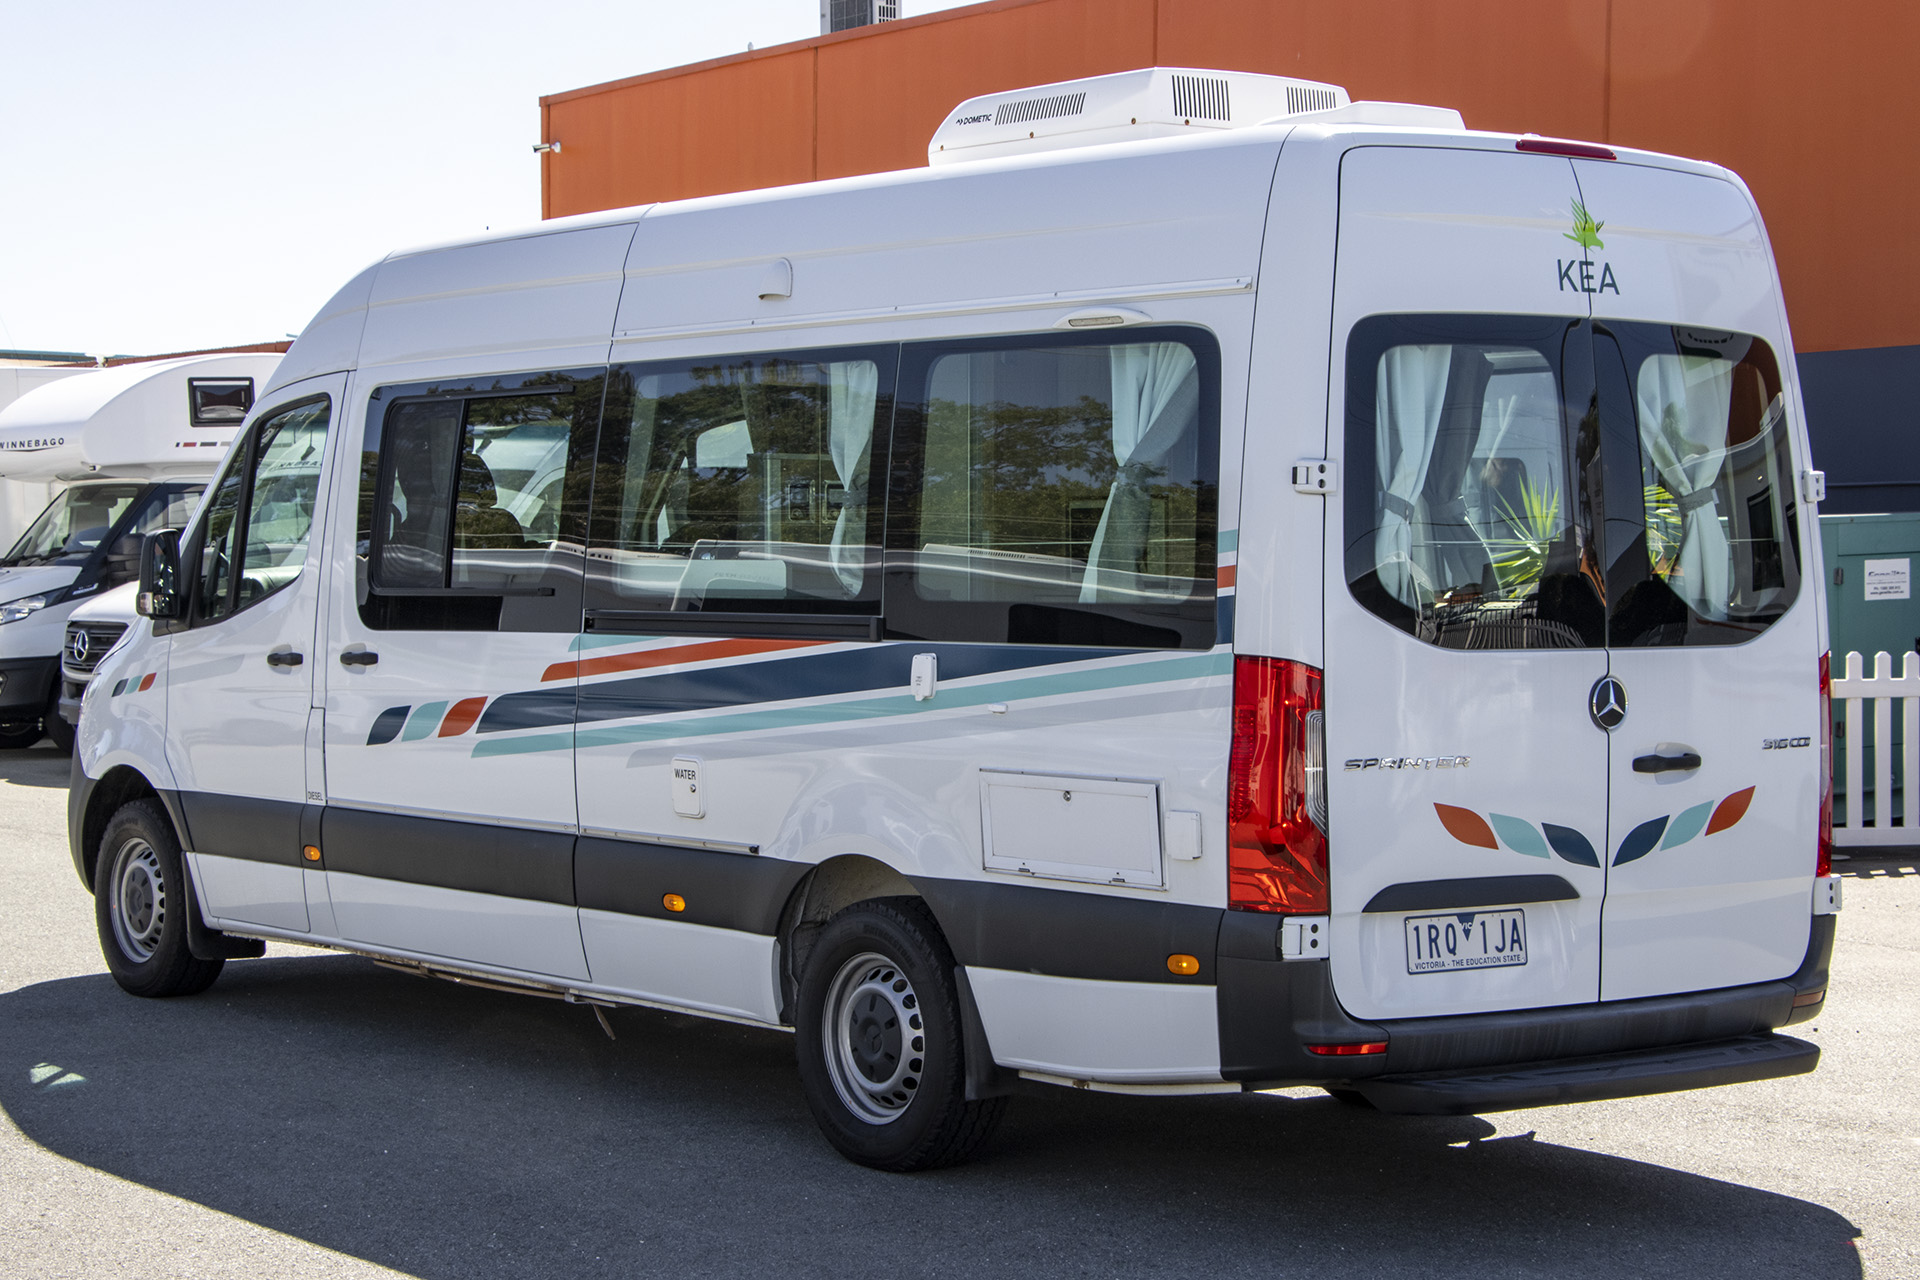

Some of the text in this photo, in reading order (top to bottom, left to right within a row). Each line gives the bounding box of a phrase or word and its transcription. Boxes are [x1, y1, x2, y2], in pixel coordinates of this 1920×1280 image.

[963, 113, 992, 125] DOMETIC
[1557, 259, 1620, 295] KEA
[1344, 755, 1471, 771] SPRINTER
[674, 768, 697, 780] WATER
[308, 791, 324, 801] DIESEL
[1413, 918, 1523, 960] 1RQ 1JA
[1415, 961, 1446, 970] VICTORIA
[1452, 959, 1464, 967] THE
[1466, 956, 1501, 965] EDUCATION
[1503, 954, 1521, 963] STATE
